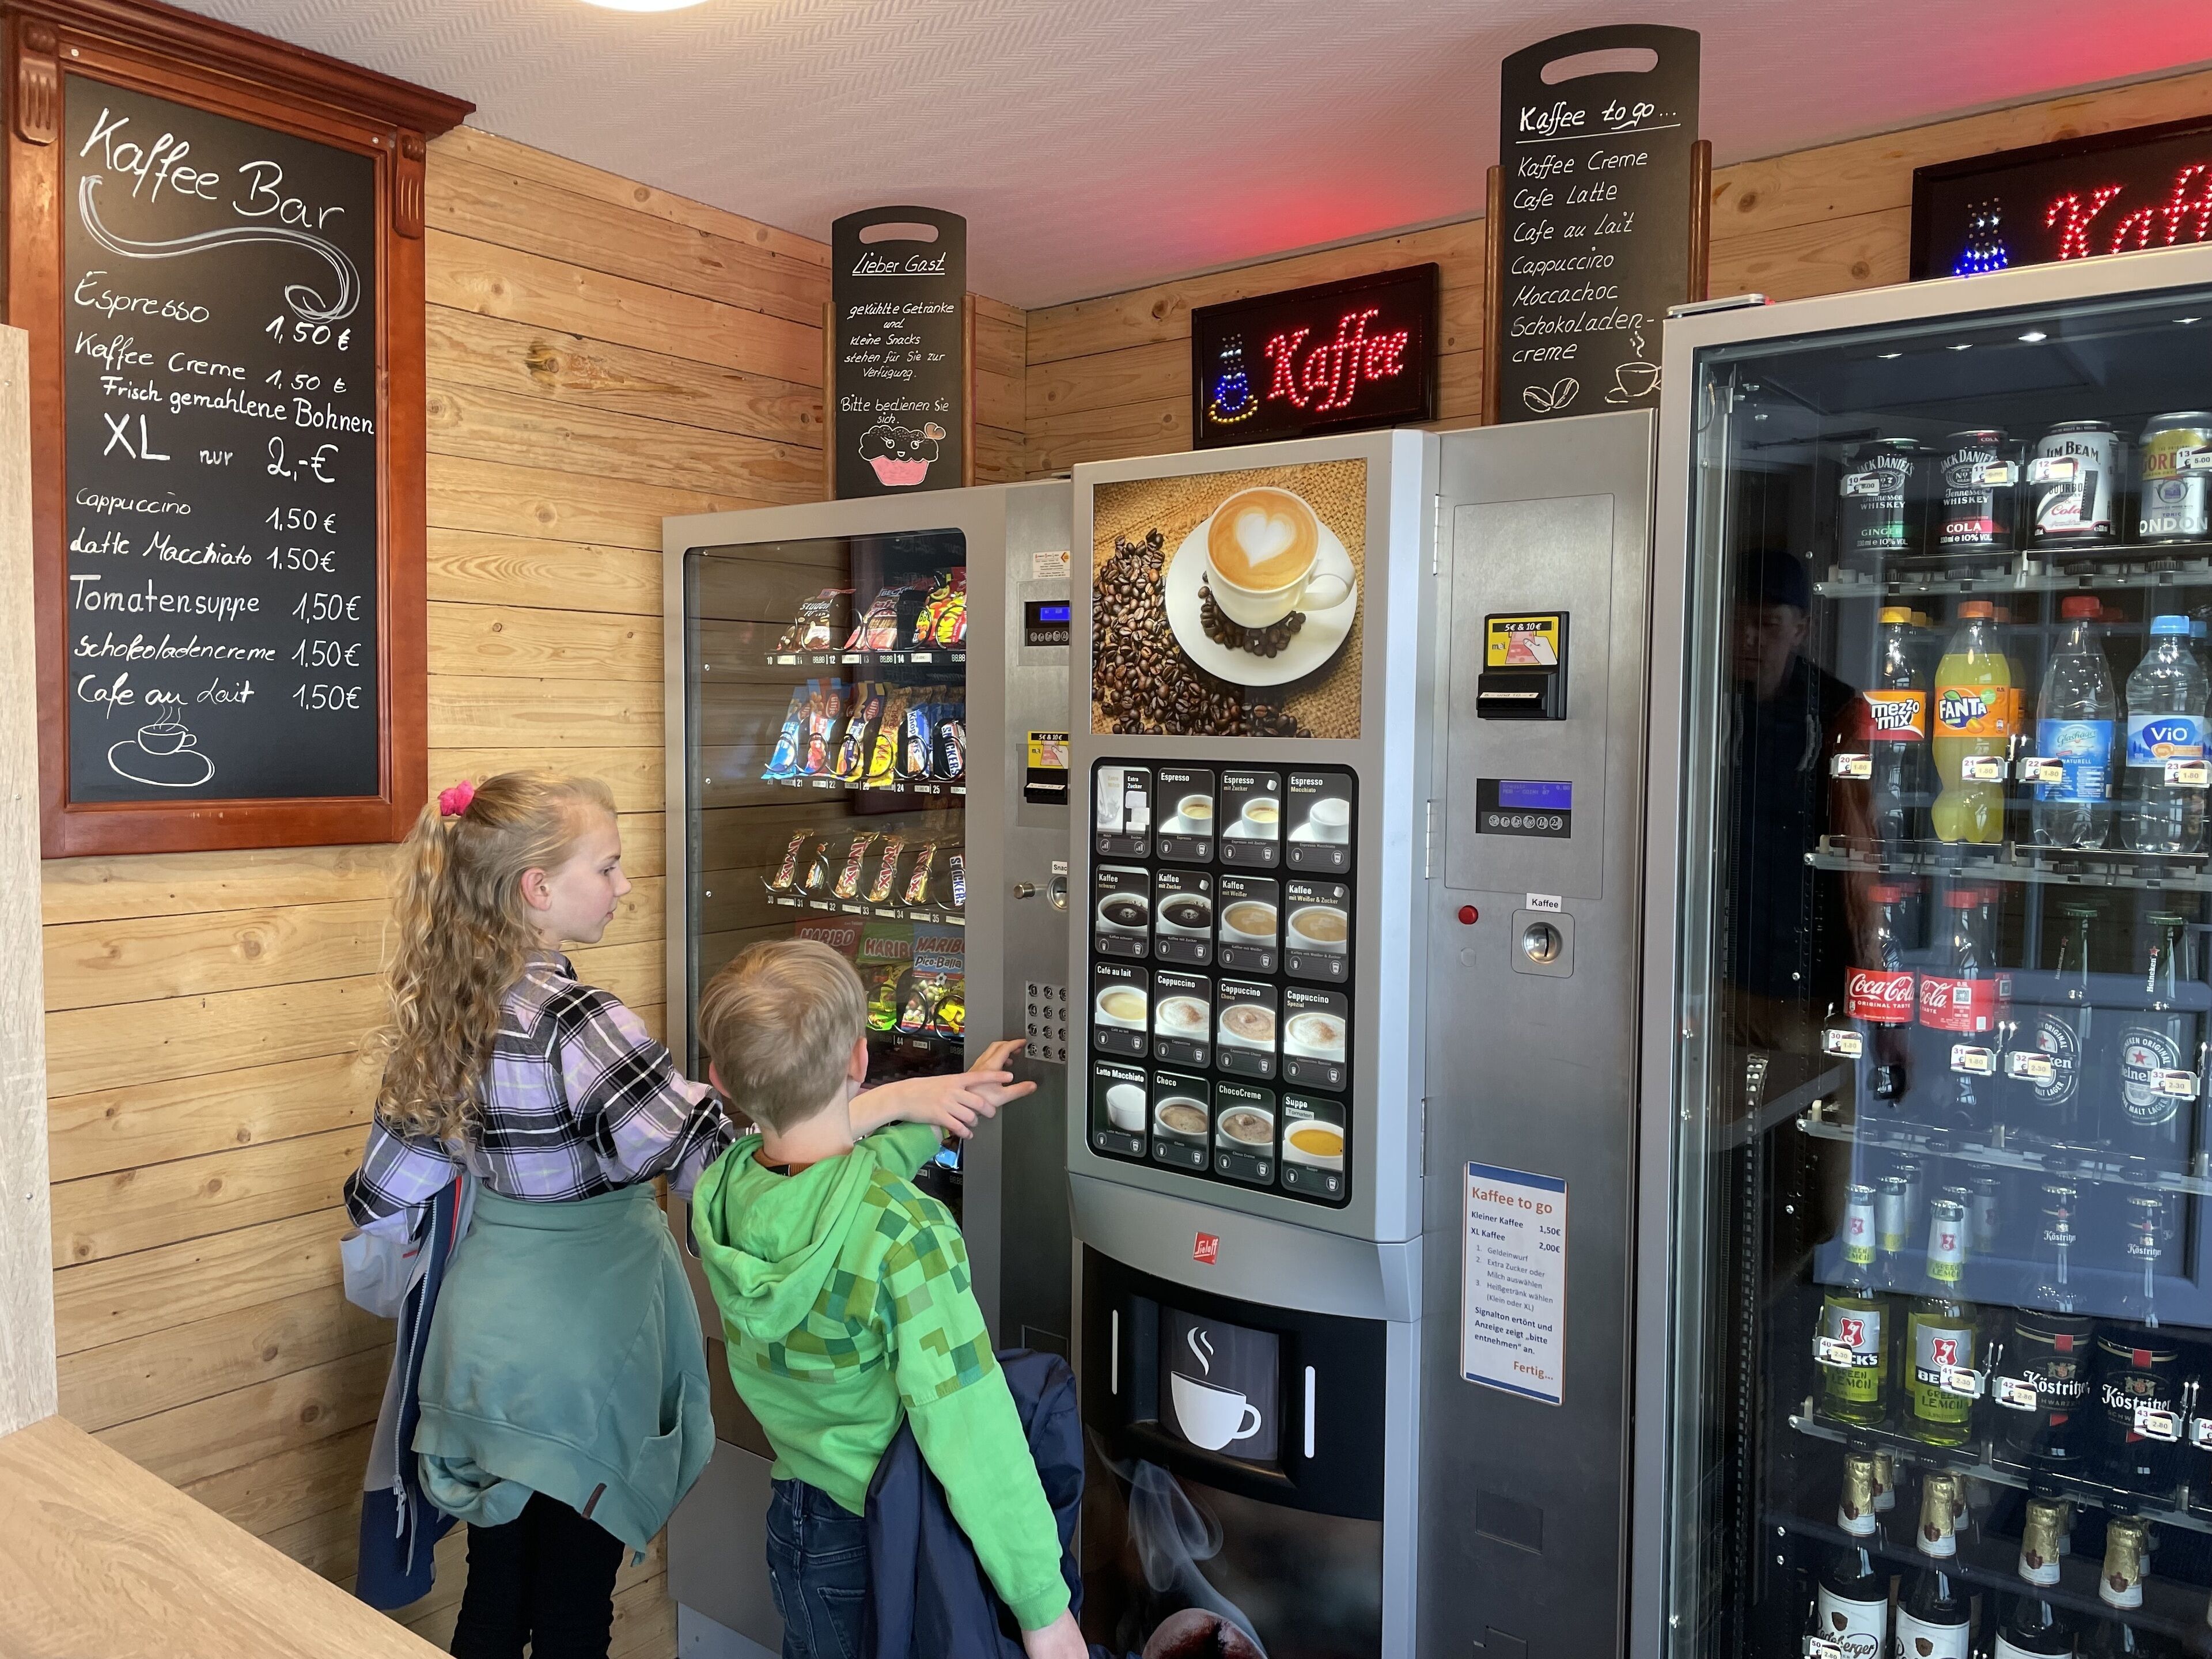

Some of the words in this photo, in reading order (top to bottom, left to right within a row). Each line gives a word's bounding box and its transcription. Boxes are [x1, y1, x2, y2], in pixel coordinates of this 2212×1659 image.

[1518, 101, 1585, 137] Kaffee
[1601, 99, 1626, 122] to
[79, 108, 219, 203] Kaffee
[233, 161, 344, 229] Bar
[1518, 154, 1574, 179] Kaffee
[1588, 150, 1648, 171] Creme
[1513, 188, 1553, 211] Cafe
[1567, 181, 1618, 204] Latte
[1513, 219, 1554, 244] Cafe
[1564, 224, 1585, 238] au
[1594, 211, 1634, 236] Lait
[852, 251, 899, 274] Lieber
[904, 251, 946, 273] Gast
[1512, 247, 1614, 276] Cappuccino
[74, 271, 210, 323] Espresso
[1513, 282, 1618, 307] Moccachoc
[902, 301, 955, 315] Getränke
[883, 319, 905, 329] und
[850, 333, 881, 346] kleine
[885, 334, 921, 345] Snacks
[75, 331, 154, 371] Kaffee
[168, 353, 245, 380] Creme
[844, 352, 880, 363] stehen
[883, 351, 900, 364] für
[907, 349, 922, 362] Sie
[927, 353, 945, 362] zur
[1264, 308, 1408, 412] Kaffee
[1512, 343, 1578, 363] creme
[100, 376, 163, 403] Frisch
[170, 388, 287, 420] gemahlene
[293, 397, 374, 435] Bohnen
[840, 394, 870, 412] Bitte
[875, 396, 929, 412] bedienen
[934, 396, 949, 411] Sie
[104, 412, 171, 461] XL
[199, 448, 233, 466] nur
[2047, 446, 2062, 457] JIM
[2066, 441, 2099, 460] BEAM
[1941, 456, 1959, 474] JACK
[76, 487, 191, 515] Cappuccino
[1860, 502, 1906, 510] WHISKEY
[1944, 497, 1988, 505] WHISKEY
[2051, 505, 2081, 516] Cola
[1861, 528, 1902, 536] GINGER
[1946, 522, 1982, 533] COLA
[2139, 517, 2207, 533] ONDON
[142, 531, 252, 566] Macchiato
[69, 574, 260, 623] Tomatensuppe
[74, 632, 276, 662] Schokoladencreme
[77, 672, 135, 720] Cafe
[145, 688, 188, 706] au
[1872, 699, 1920, 718] mezzo
[1939, 696, 1986, 719] FANTA
[1161, 772, 1190, 783] Espresso
[1224, 775, 1254, 785] Espresso
[1291, 777, 1323, 786] Espresso
[1099, 874, 1118, 882] Kaffee
[1159, 873, 1179, 882] Kaffee
[1223, 880, 1244, 889] Kaffee
[1289, 885, 1312, 894] Kaffee
[1532, 899, 1559, 908] Kaffee
[800, 928, 855, 946] HARIBO
[914, 956, 963, 969] Pico-Balla
[1097, 966, 1111, 975] Café
[1158, 975, 1195, 988] Cappuccino
[2146, 958, 2156, 993] Heineken
[1221, 983, 1261, 996] Cappuccino
[1287, 990, 1329, 1003] Cappuccino
[1096, 1067, 1111, 1077] Latte
[1112, 1070, 1145, 1082] Macchiato
[1157, 1075, 1176, 1086] Choco
[1219, 1085, 1262, 1100] ChocoCreme
[1285, 1096, 1308, 1109] Suppe
[1472, 1187, 1514, 1206] Kaffee
[1518, 1197, 1532, 1209] to
[1536, 1203, 1552, 1214] go
[1471, 1211, 1497, 1223] Kleiner
[1499, 1217, 1524, 1228] Kaffee
[1471, 1228, 1480, 1236] XL
[1482, 1229, 1505, 1241] Kaffee
[1488, 1247, 1528, 1262] Geldeinwurf
[1487, 1259, 1504, 1268] Extra
[1506, 1263, 1528, 1273] Zucker
[1529, 1268, 1545, 1278] oder
[1487, 1271, 1505, 1280] Milch
[1506, 1276, 1542, 1289] auswählen
[1507, 1299, 1522, 1308] oder
[1529, 1293, 1553, 1304] wählen
[1475, 1306, 1510, 1321] Signalton
[1512, 1316, 1535, 1328] ertönt
[1537, 1323, 1552, 1332] und
[1475, 1320, 1503, 1333] Anzeige
[1506, 1328, 1524, 1339] zeigt
